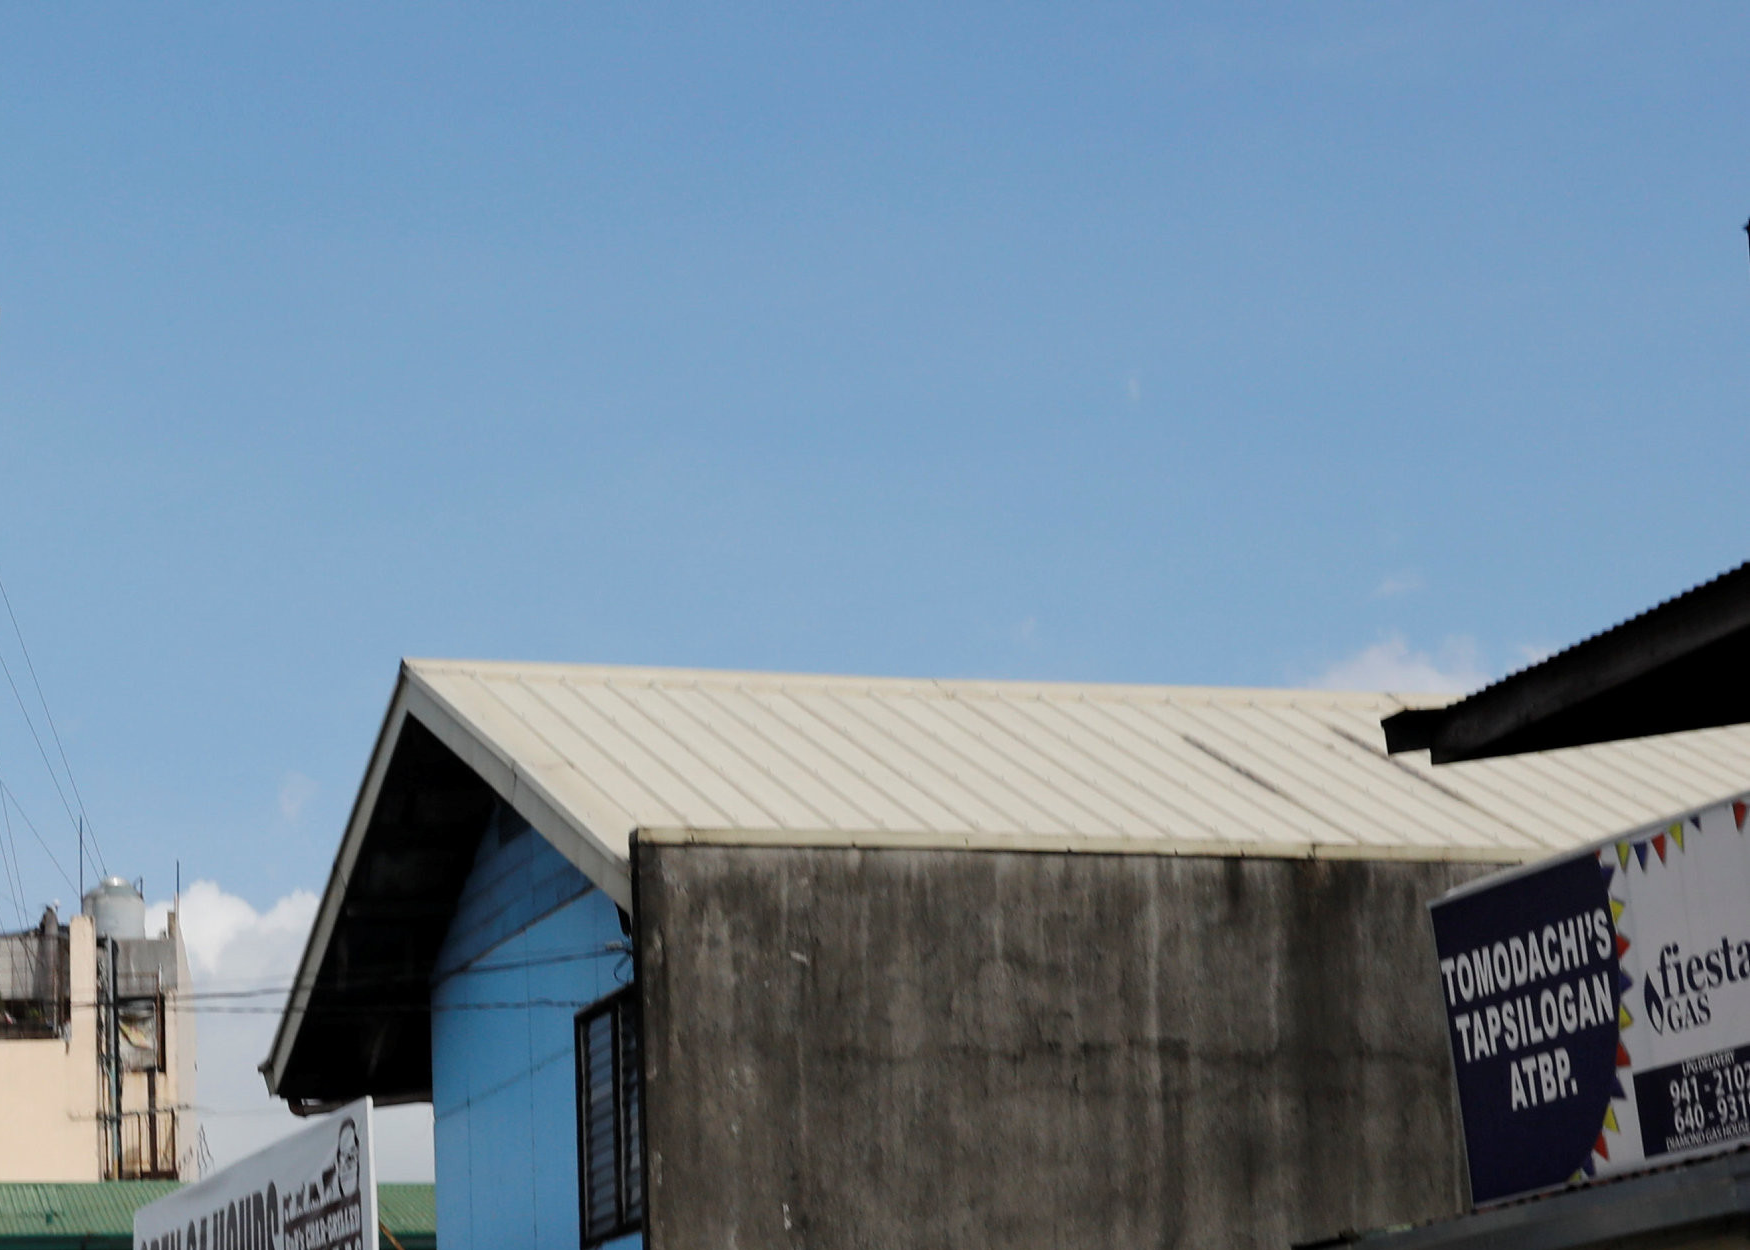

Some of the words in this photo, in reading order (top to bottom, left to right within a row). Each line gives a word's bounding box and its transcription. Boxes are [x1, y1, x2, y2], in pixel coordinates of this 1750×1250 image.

[1440, 909, 1612, 1007] TOMODACHI'S
[1657, 936, 1750, 1000] fiesta
[1455, 971, 1615, 1063] TAPSILOGAN
[1667, 994, 1711, 1034] GAS
[1510, 1047, 1578, 1112] ATBP.
[1697, 1051, 1735, 1073] DELIVERY
[1670, 1075, 1699, 1109] 941
[1674, 1103, 1705, 1134] 640
[1717, 1092, 1750, 1124] 931
[1666, 1131, 1704, 1153] DIAMOND
[1705, 1124, 1722, 1143] GAS
